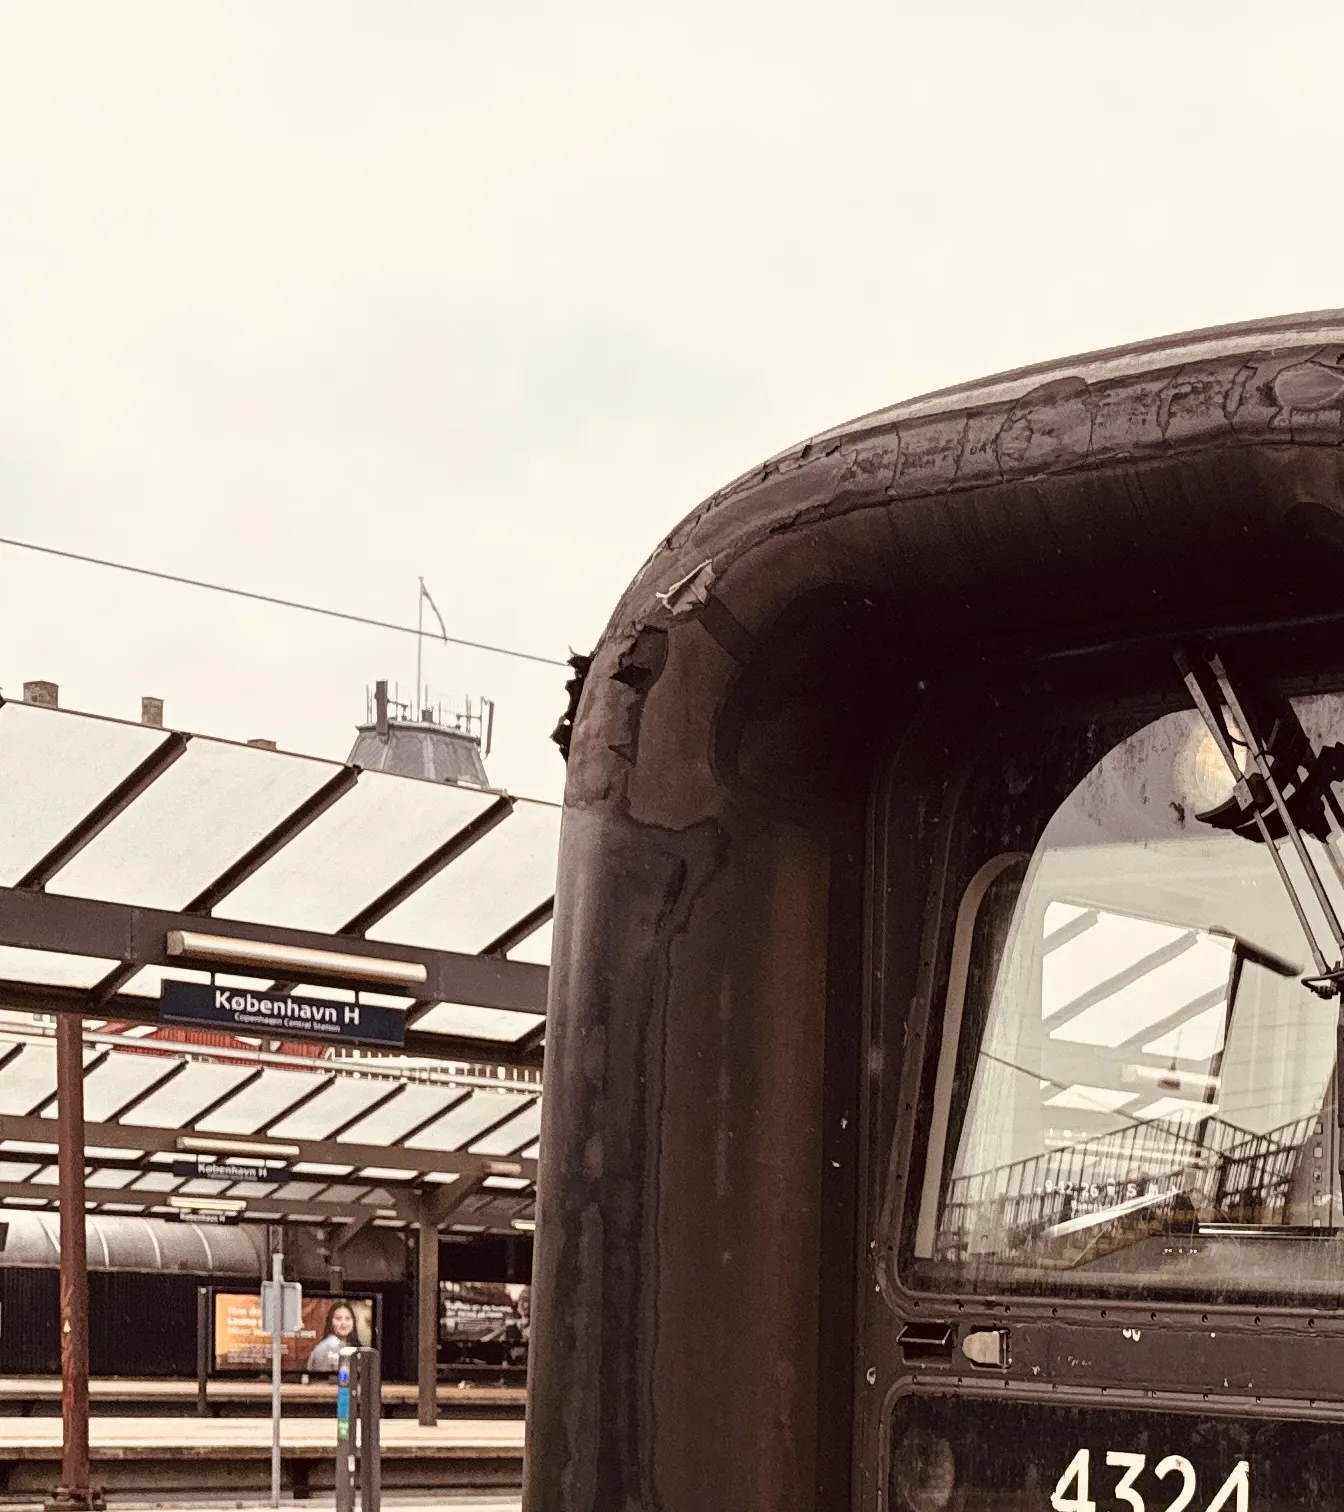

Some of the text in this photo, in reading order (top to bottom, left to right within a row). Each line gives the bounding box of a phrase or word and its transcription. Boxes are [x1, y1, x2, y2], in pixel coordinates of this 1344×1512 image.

[215, 990, 360, 1025] København H
[234, 1012, 283, 1027] Copenhagen
